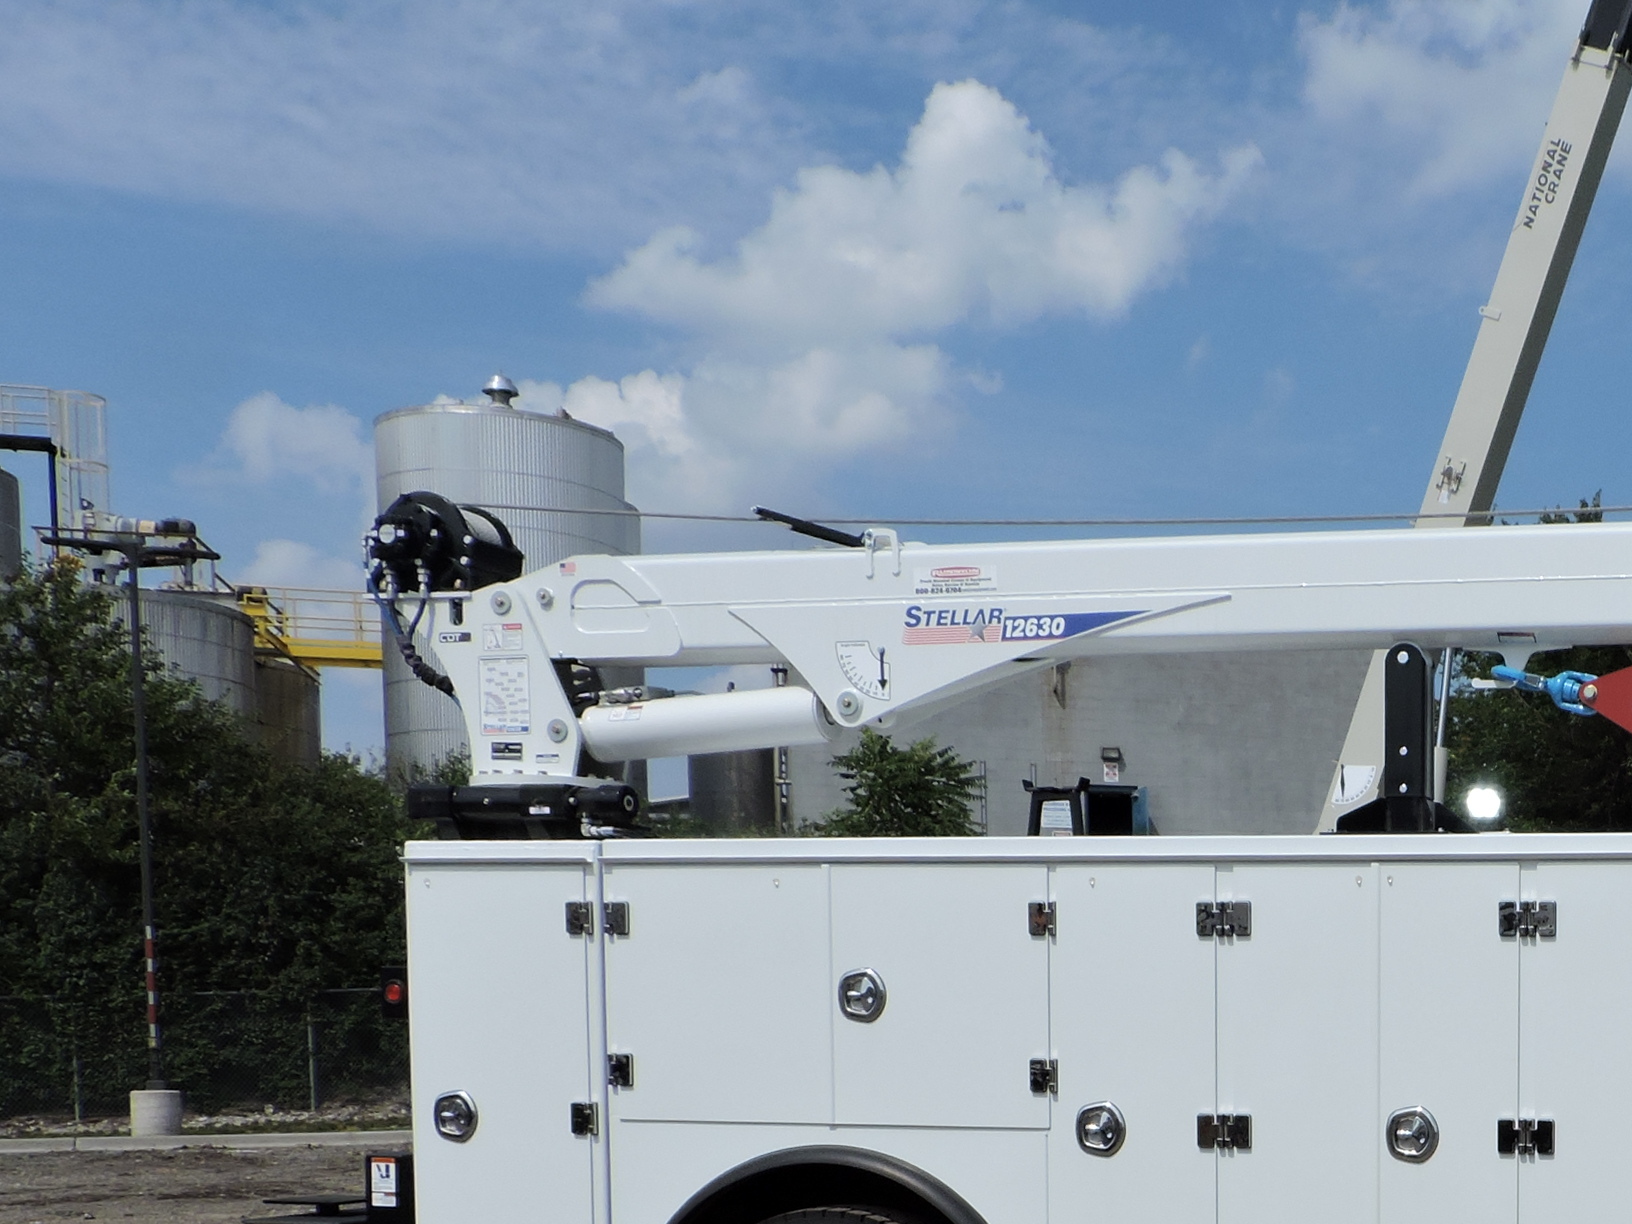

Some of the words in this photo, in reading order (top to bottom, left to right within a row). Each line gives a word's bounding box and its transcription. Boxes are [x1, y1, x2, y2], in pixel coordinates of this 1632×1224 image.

[1523, 138, 1562, 229] NATIONAL
[1544, 140, 1573, 205] CRANE
[904, 605, 1003, 628] STELLAR
[1005, 616, 1066, 638] 12630
